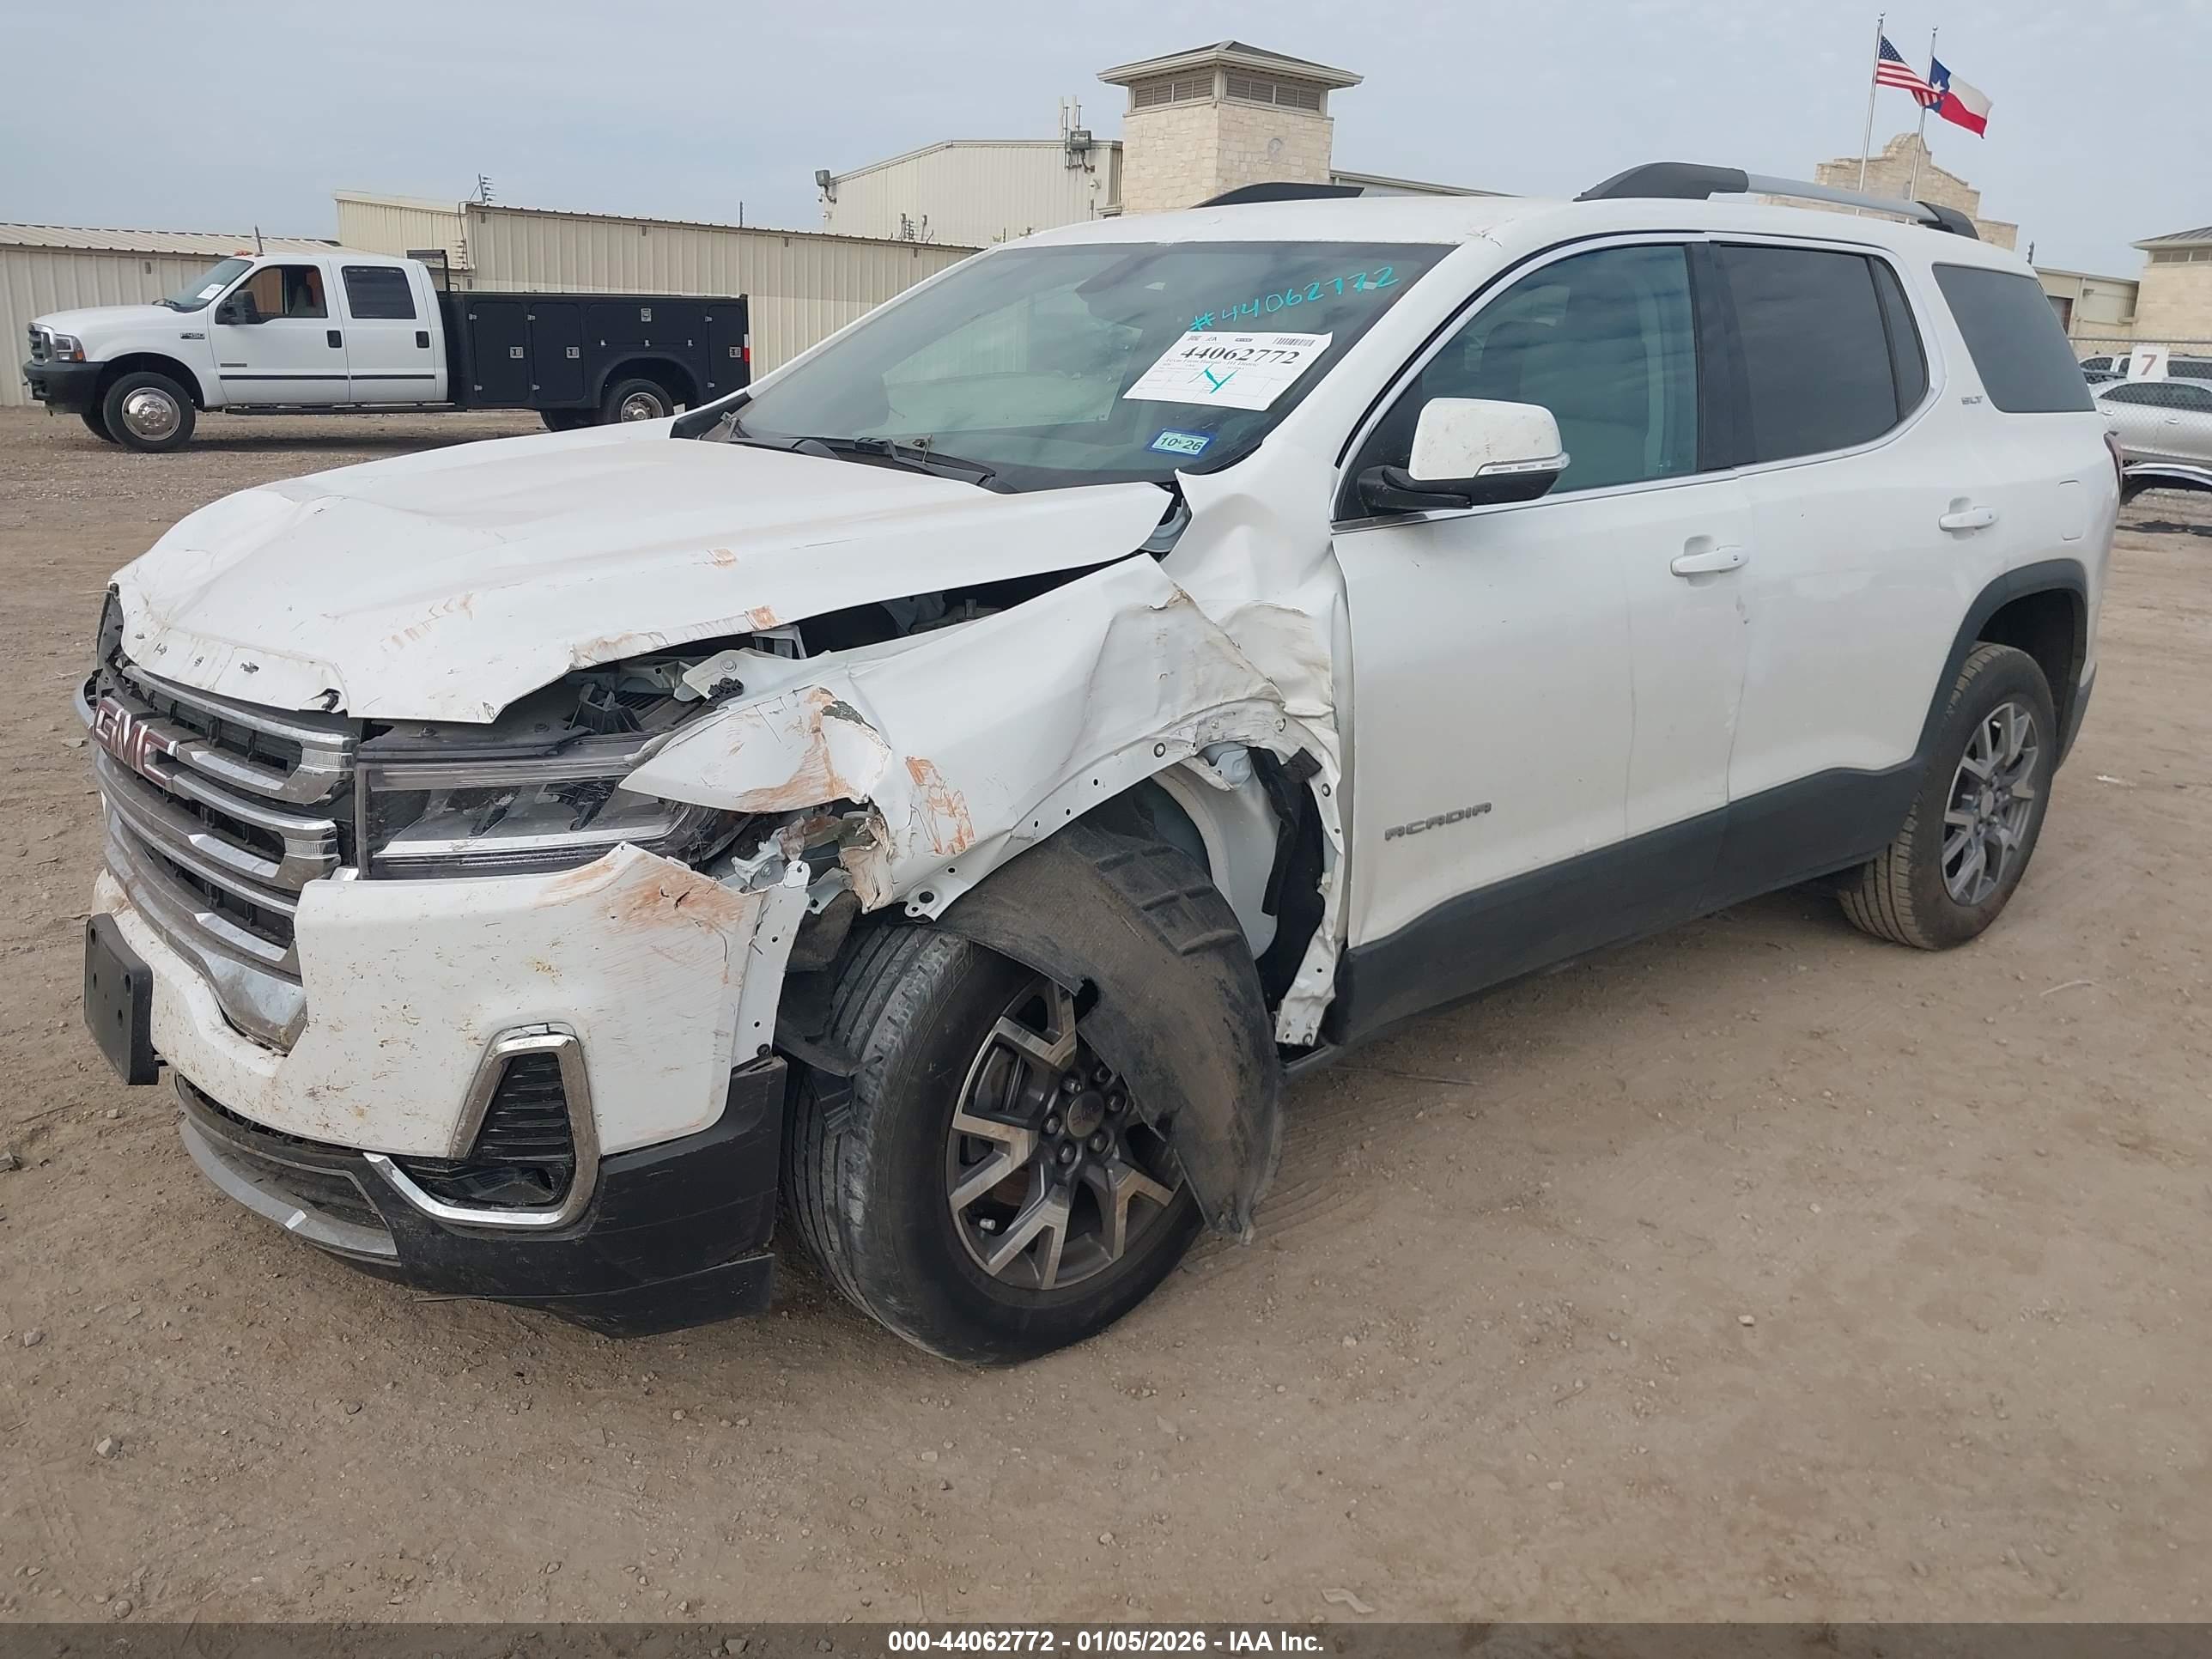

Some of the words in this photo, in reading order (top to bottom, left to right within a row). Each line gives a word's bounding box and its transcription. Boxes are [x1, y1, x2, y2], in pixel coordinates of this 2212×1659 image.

[1189, 266, 1400, 331] #44062772
[1181, 346, 1301, 364] 44062772
[2141, 355, 2157, 375] 7
[93, 696, 179, 791] GMC
[1384, 801, 1492, 842] ACADIA
